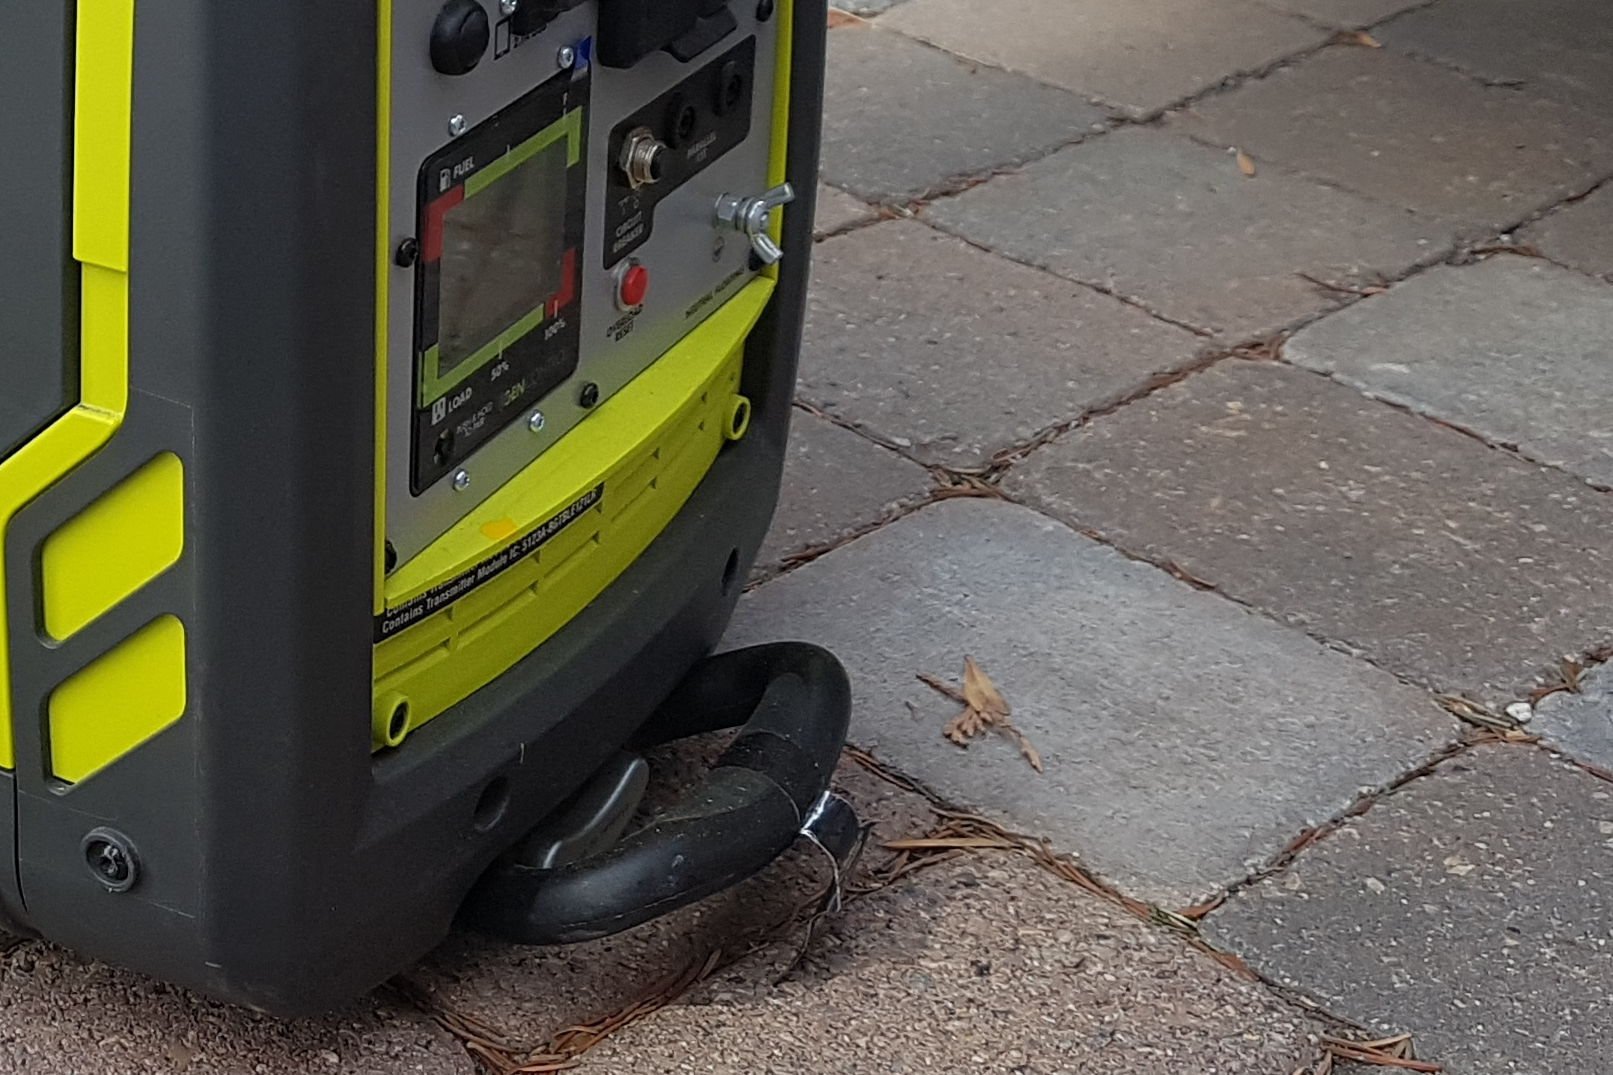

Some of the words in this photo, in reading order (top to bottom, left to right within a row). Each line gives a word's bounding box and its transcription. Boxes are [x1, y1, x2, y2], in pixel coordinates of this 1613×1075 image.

[453, 155, 475, 179] FUEL
[448, 386, 473, 413] LOAD
[381, 604, 424, 634] Contains
[426, 573, 476, 609] Transmitter
[477, 554, 508, 580] Module
